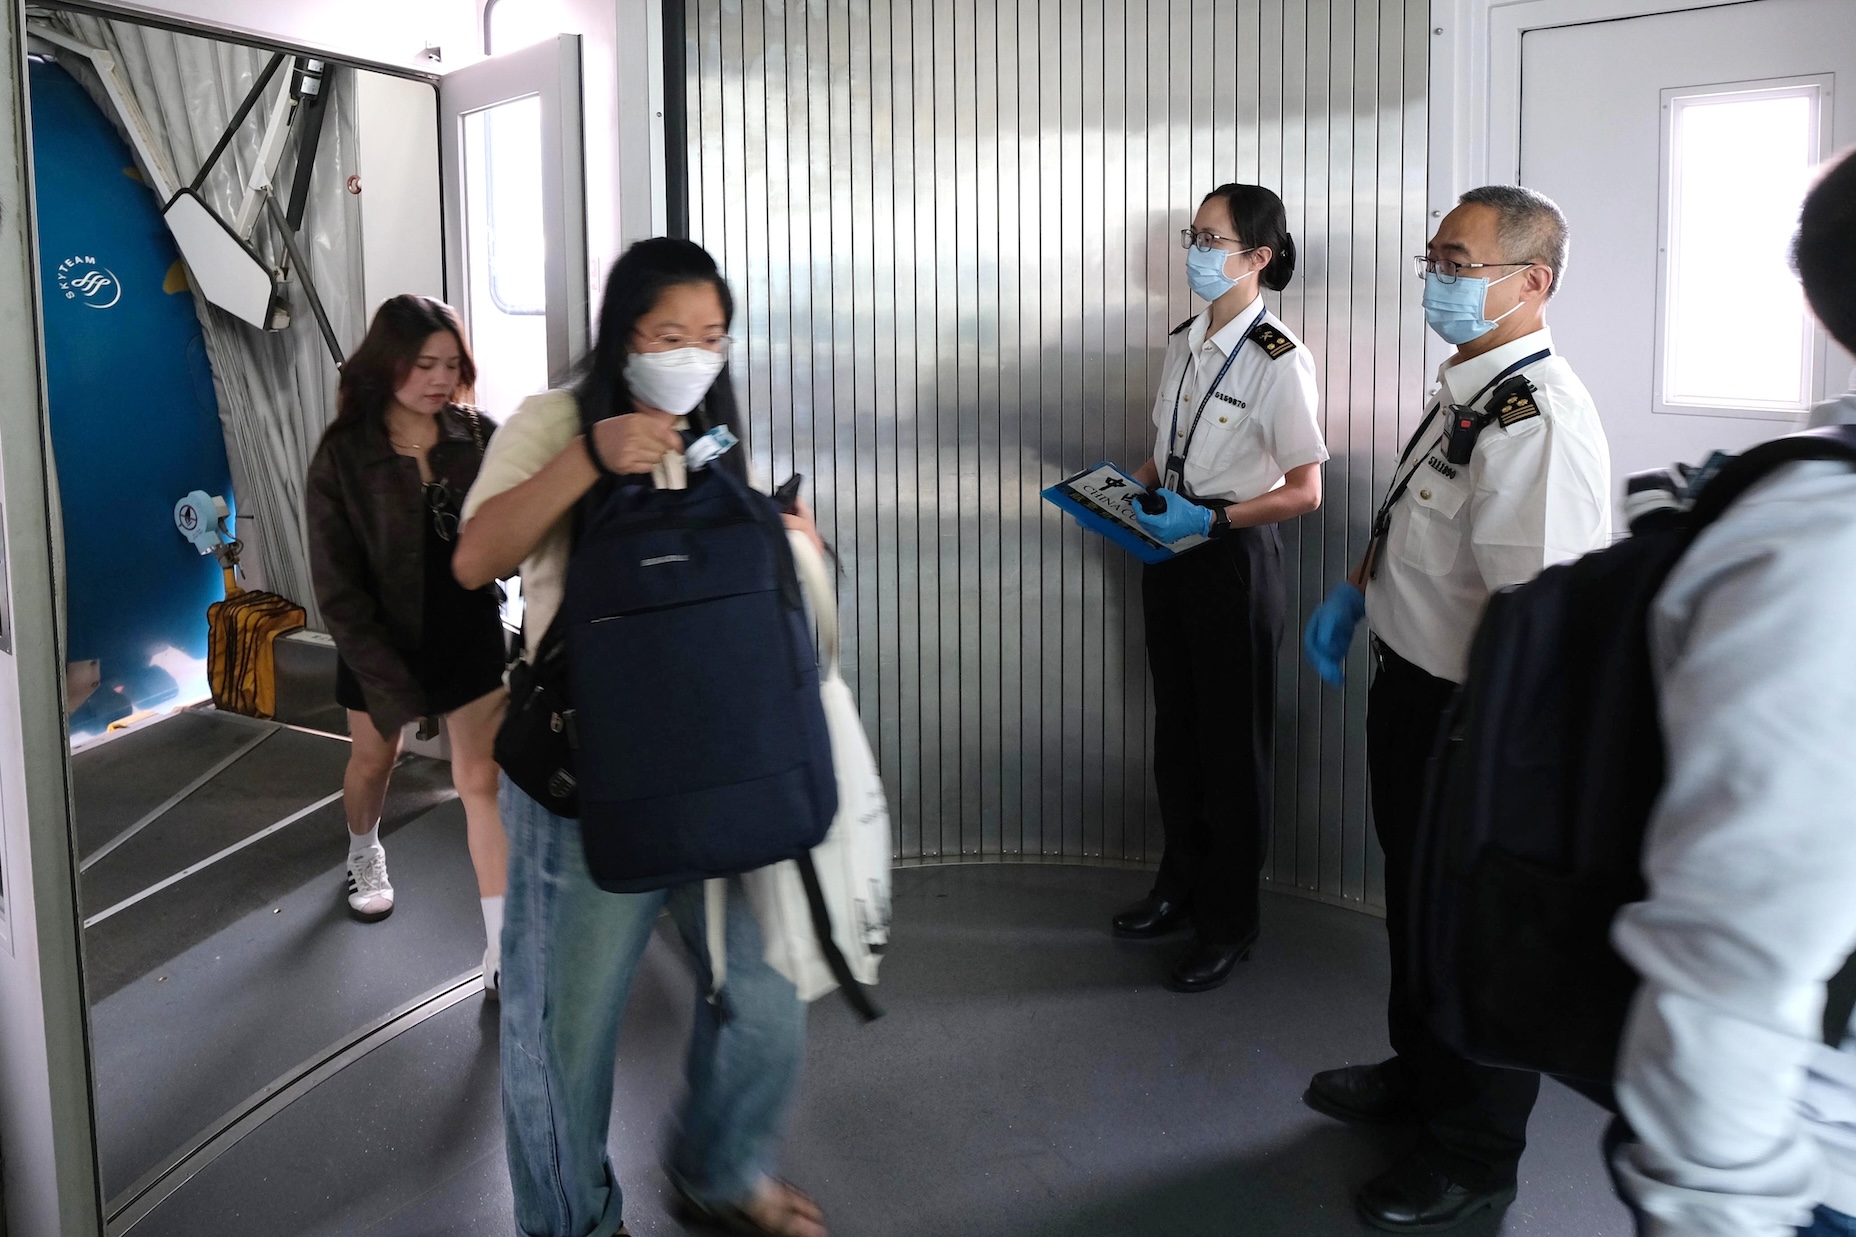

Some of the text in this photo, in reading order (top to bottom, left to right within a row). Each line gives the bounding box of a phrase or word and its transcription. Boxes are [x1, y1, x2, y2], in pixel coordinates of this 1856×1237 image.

[57, 255, 96, 300] SKYTEAM
[1083, 485, 1138, 521] CHINA CU
